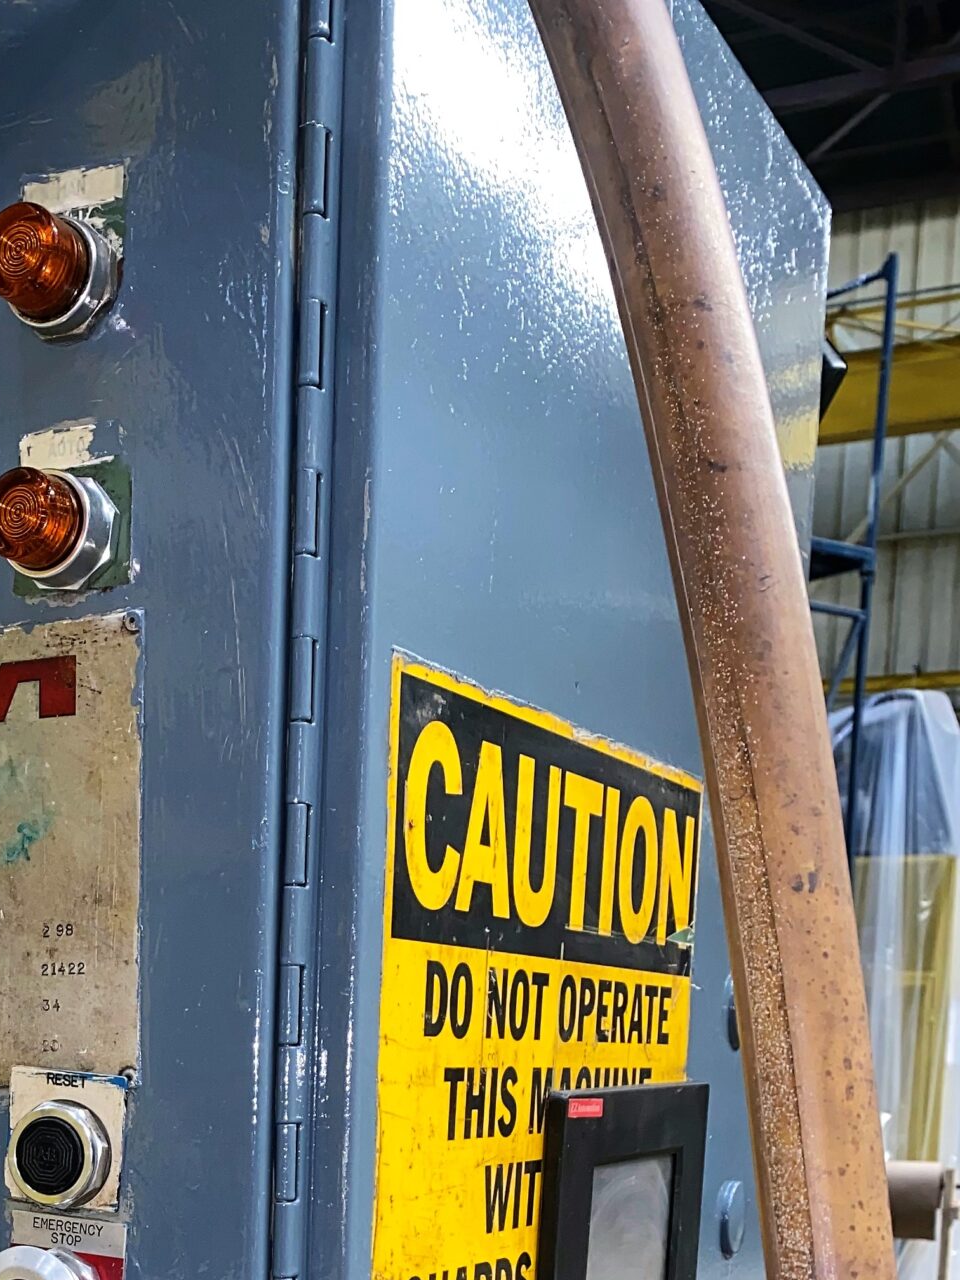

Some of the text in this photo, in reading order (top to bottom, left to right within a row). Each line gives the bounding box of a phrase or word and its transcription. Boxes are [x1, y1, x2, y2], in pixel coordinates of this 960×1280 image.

[405, 720, 695, 945] CAUTION
[41, 962, 86, 976] 21422
[42, 999, 60, 1012] 34
[424, 960, 672, 1045] DO NOT OPERATE
[46, 1072, 87, 1088] RESET
[444, 1066, 518, 1140] THIS
[485, 1159, 543, 1234] WIT
[33, 1217, 103, 1237] EMERGENCY
[51, 1232, 82, 1246] STOP
